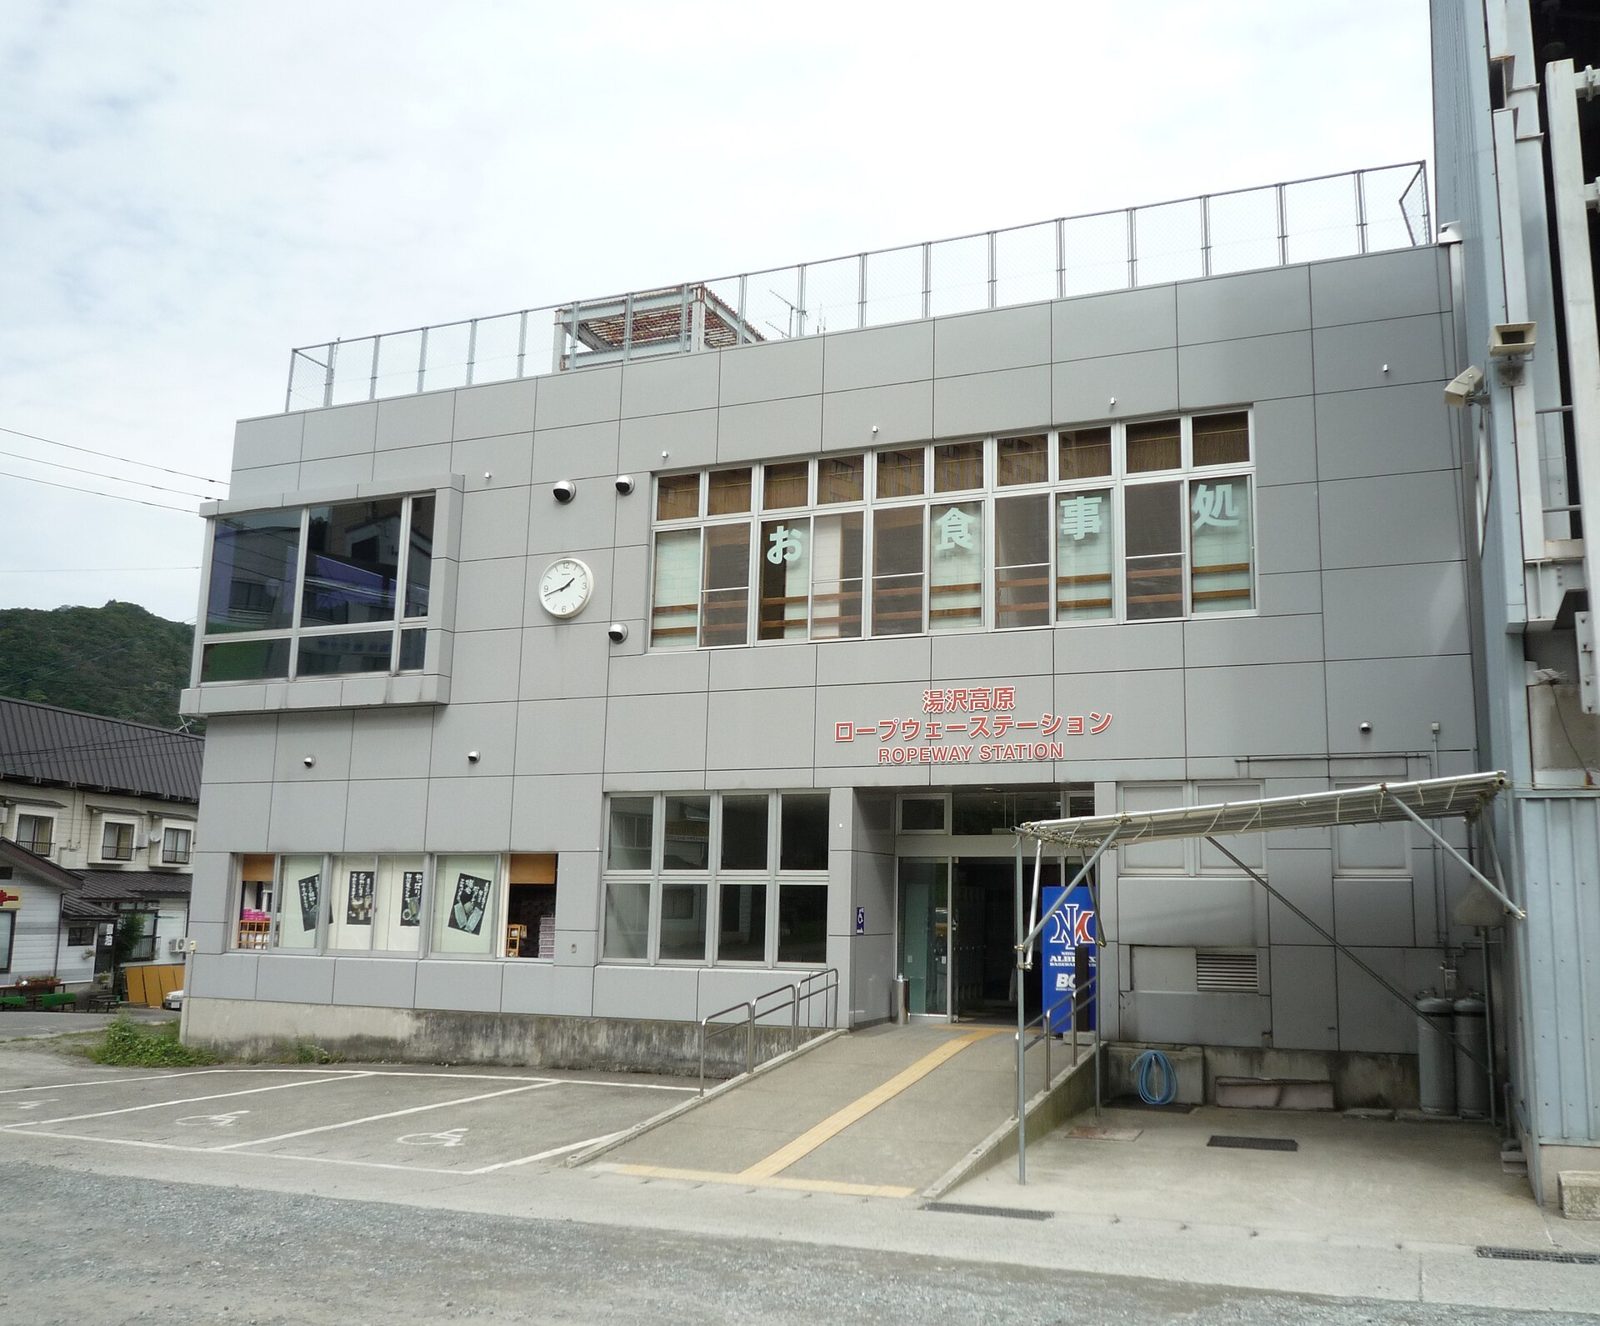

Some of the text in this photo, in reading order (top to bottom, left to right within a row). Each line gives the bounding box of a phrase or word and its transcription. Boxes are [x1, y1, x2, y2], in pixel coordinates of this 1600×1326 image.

[766, 482, 1240, 566] お食事処
[922, 686, 1016, 713] 湯沢高原
[834, 712, 1113, 743] ロープウェーステーション
[877, 742, 1064, 764] ROPEWAY STATION
